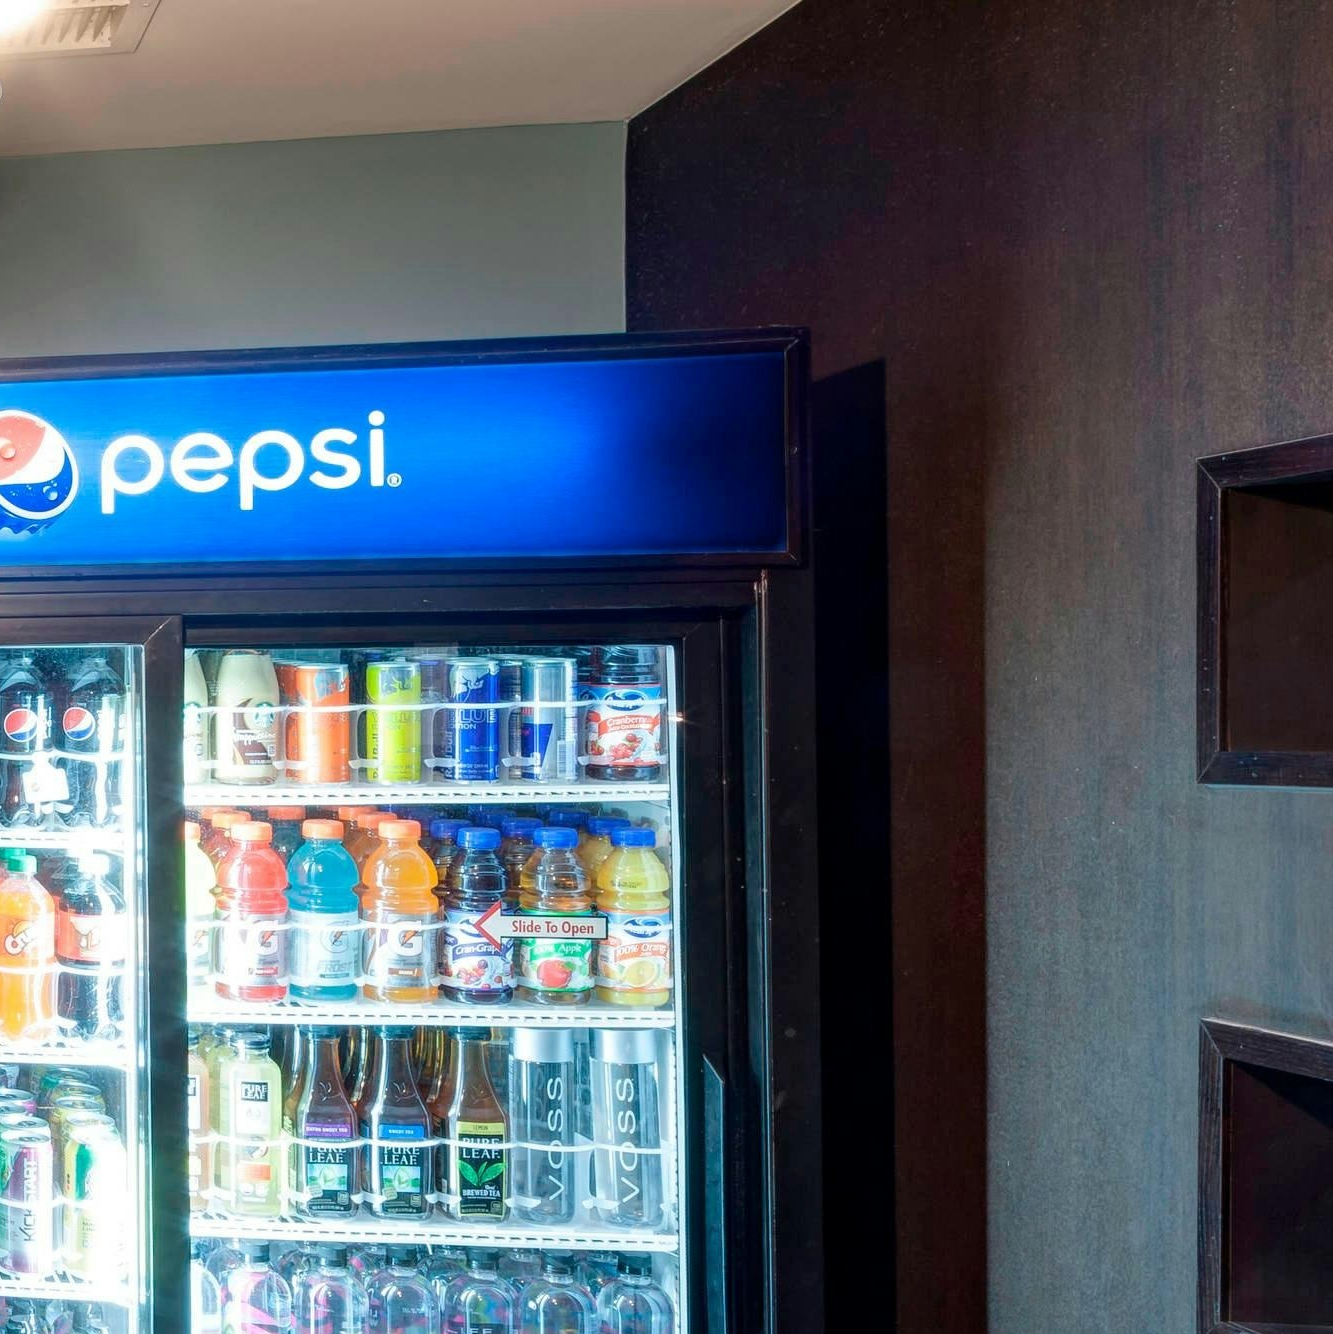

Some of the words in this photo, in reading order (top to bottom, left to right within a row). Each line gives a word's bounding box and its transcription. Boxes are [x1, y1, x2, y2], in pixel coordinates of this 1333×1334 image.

[101, 411, 384, 514] pepsi
[512, 920, 541, 933] Slide
[546, 921, 558, 934] To
[562, 922, 594, 936] Open
[455, 942, 503, 956] Cran-Grap
[242, 1083, 268, 1093] PURE
[546, 1076, 565, 1201] VOSS
[615, 1078, 641, 1203] VOSS
[462, 1189, 488, 1198] BREWED
[488, 1190, 501, 1198] TEA
